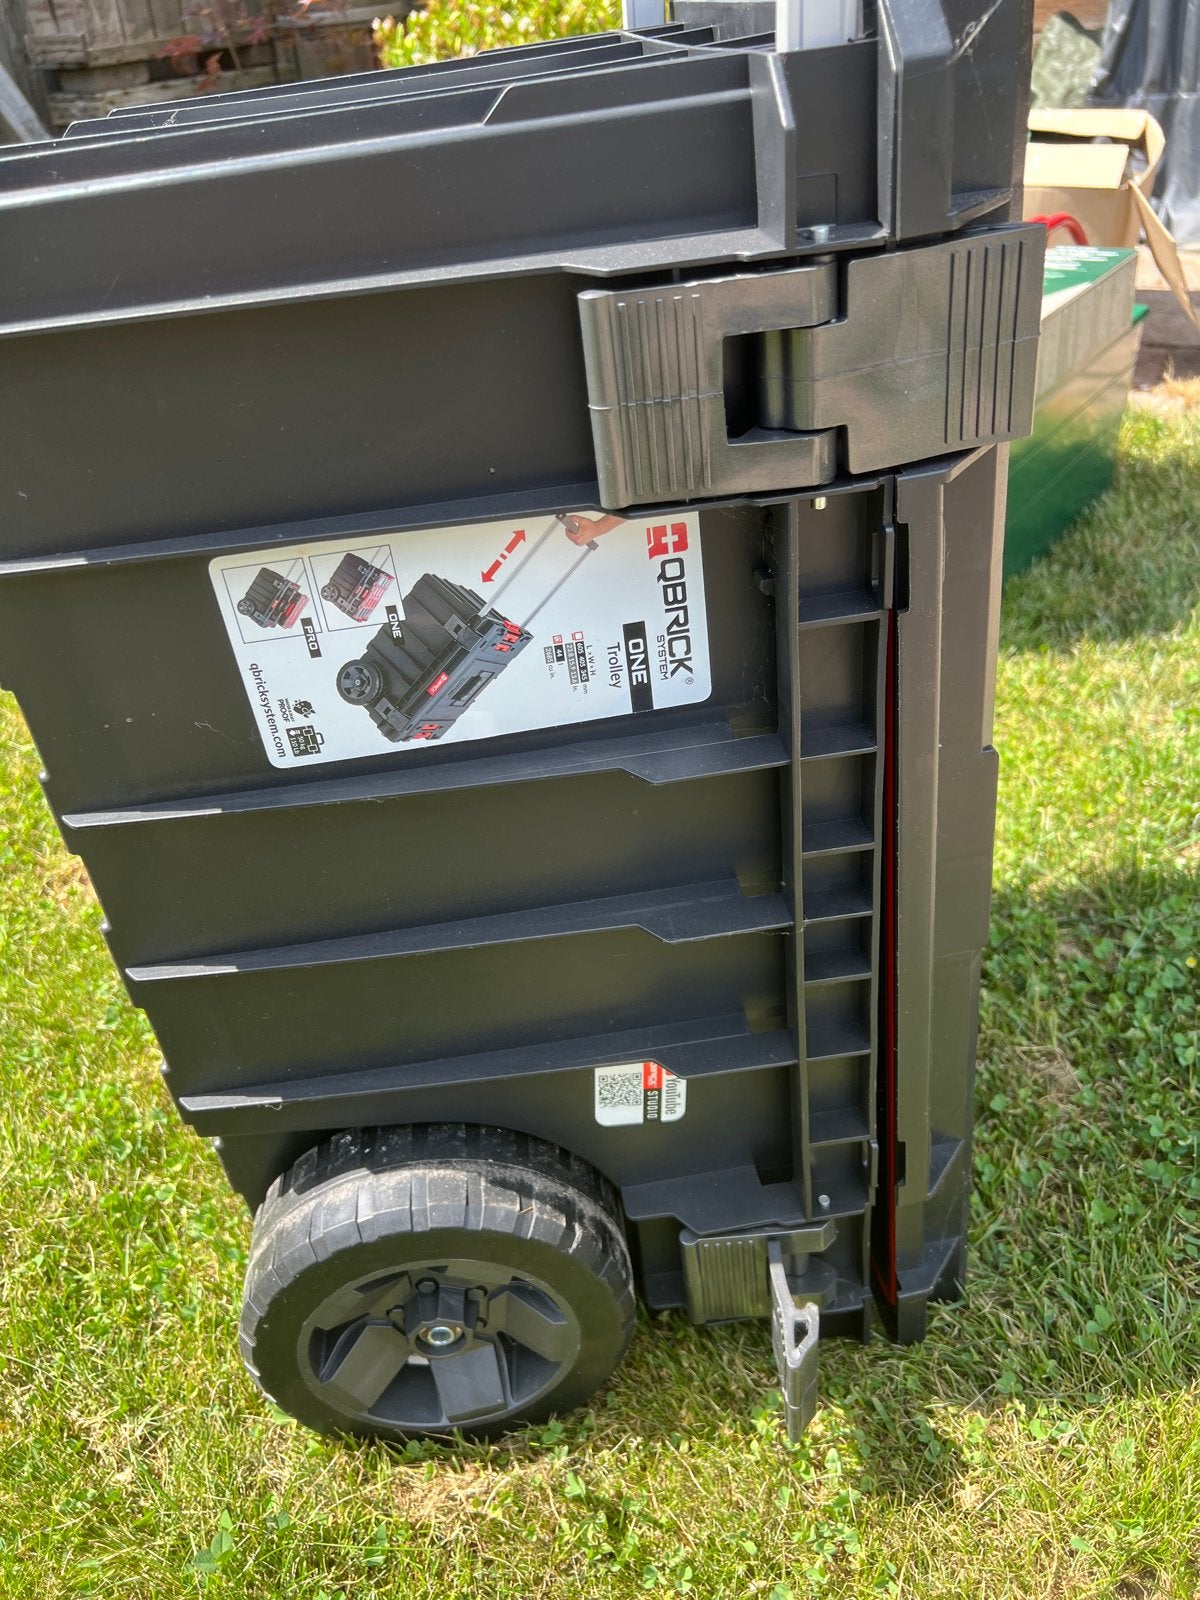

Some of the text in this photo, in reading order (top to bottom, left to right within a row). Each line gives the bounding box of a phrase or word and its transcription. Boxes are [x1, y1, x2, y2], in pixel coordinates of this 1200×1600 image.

[304, 625, 318, 650] PRO
[388, 614, 402, 638] ONE
[556, 649, 563, 657] 44
[606, 642, 623, 689] Trolley
[628, 638, 648, 686] ONE
[656, 635, 668, 680] SYSTEM
[249, 663, 286, 757] qbricksystem.com
[278, 699, 290, 722] PROOF
[646, 1090, 659, 1119] STUDIO
[665, 1078, 681, 1115] YouTube
